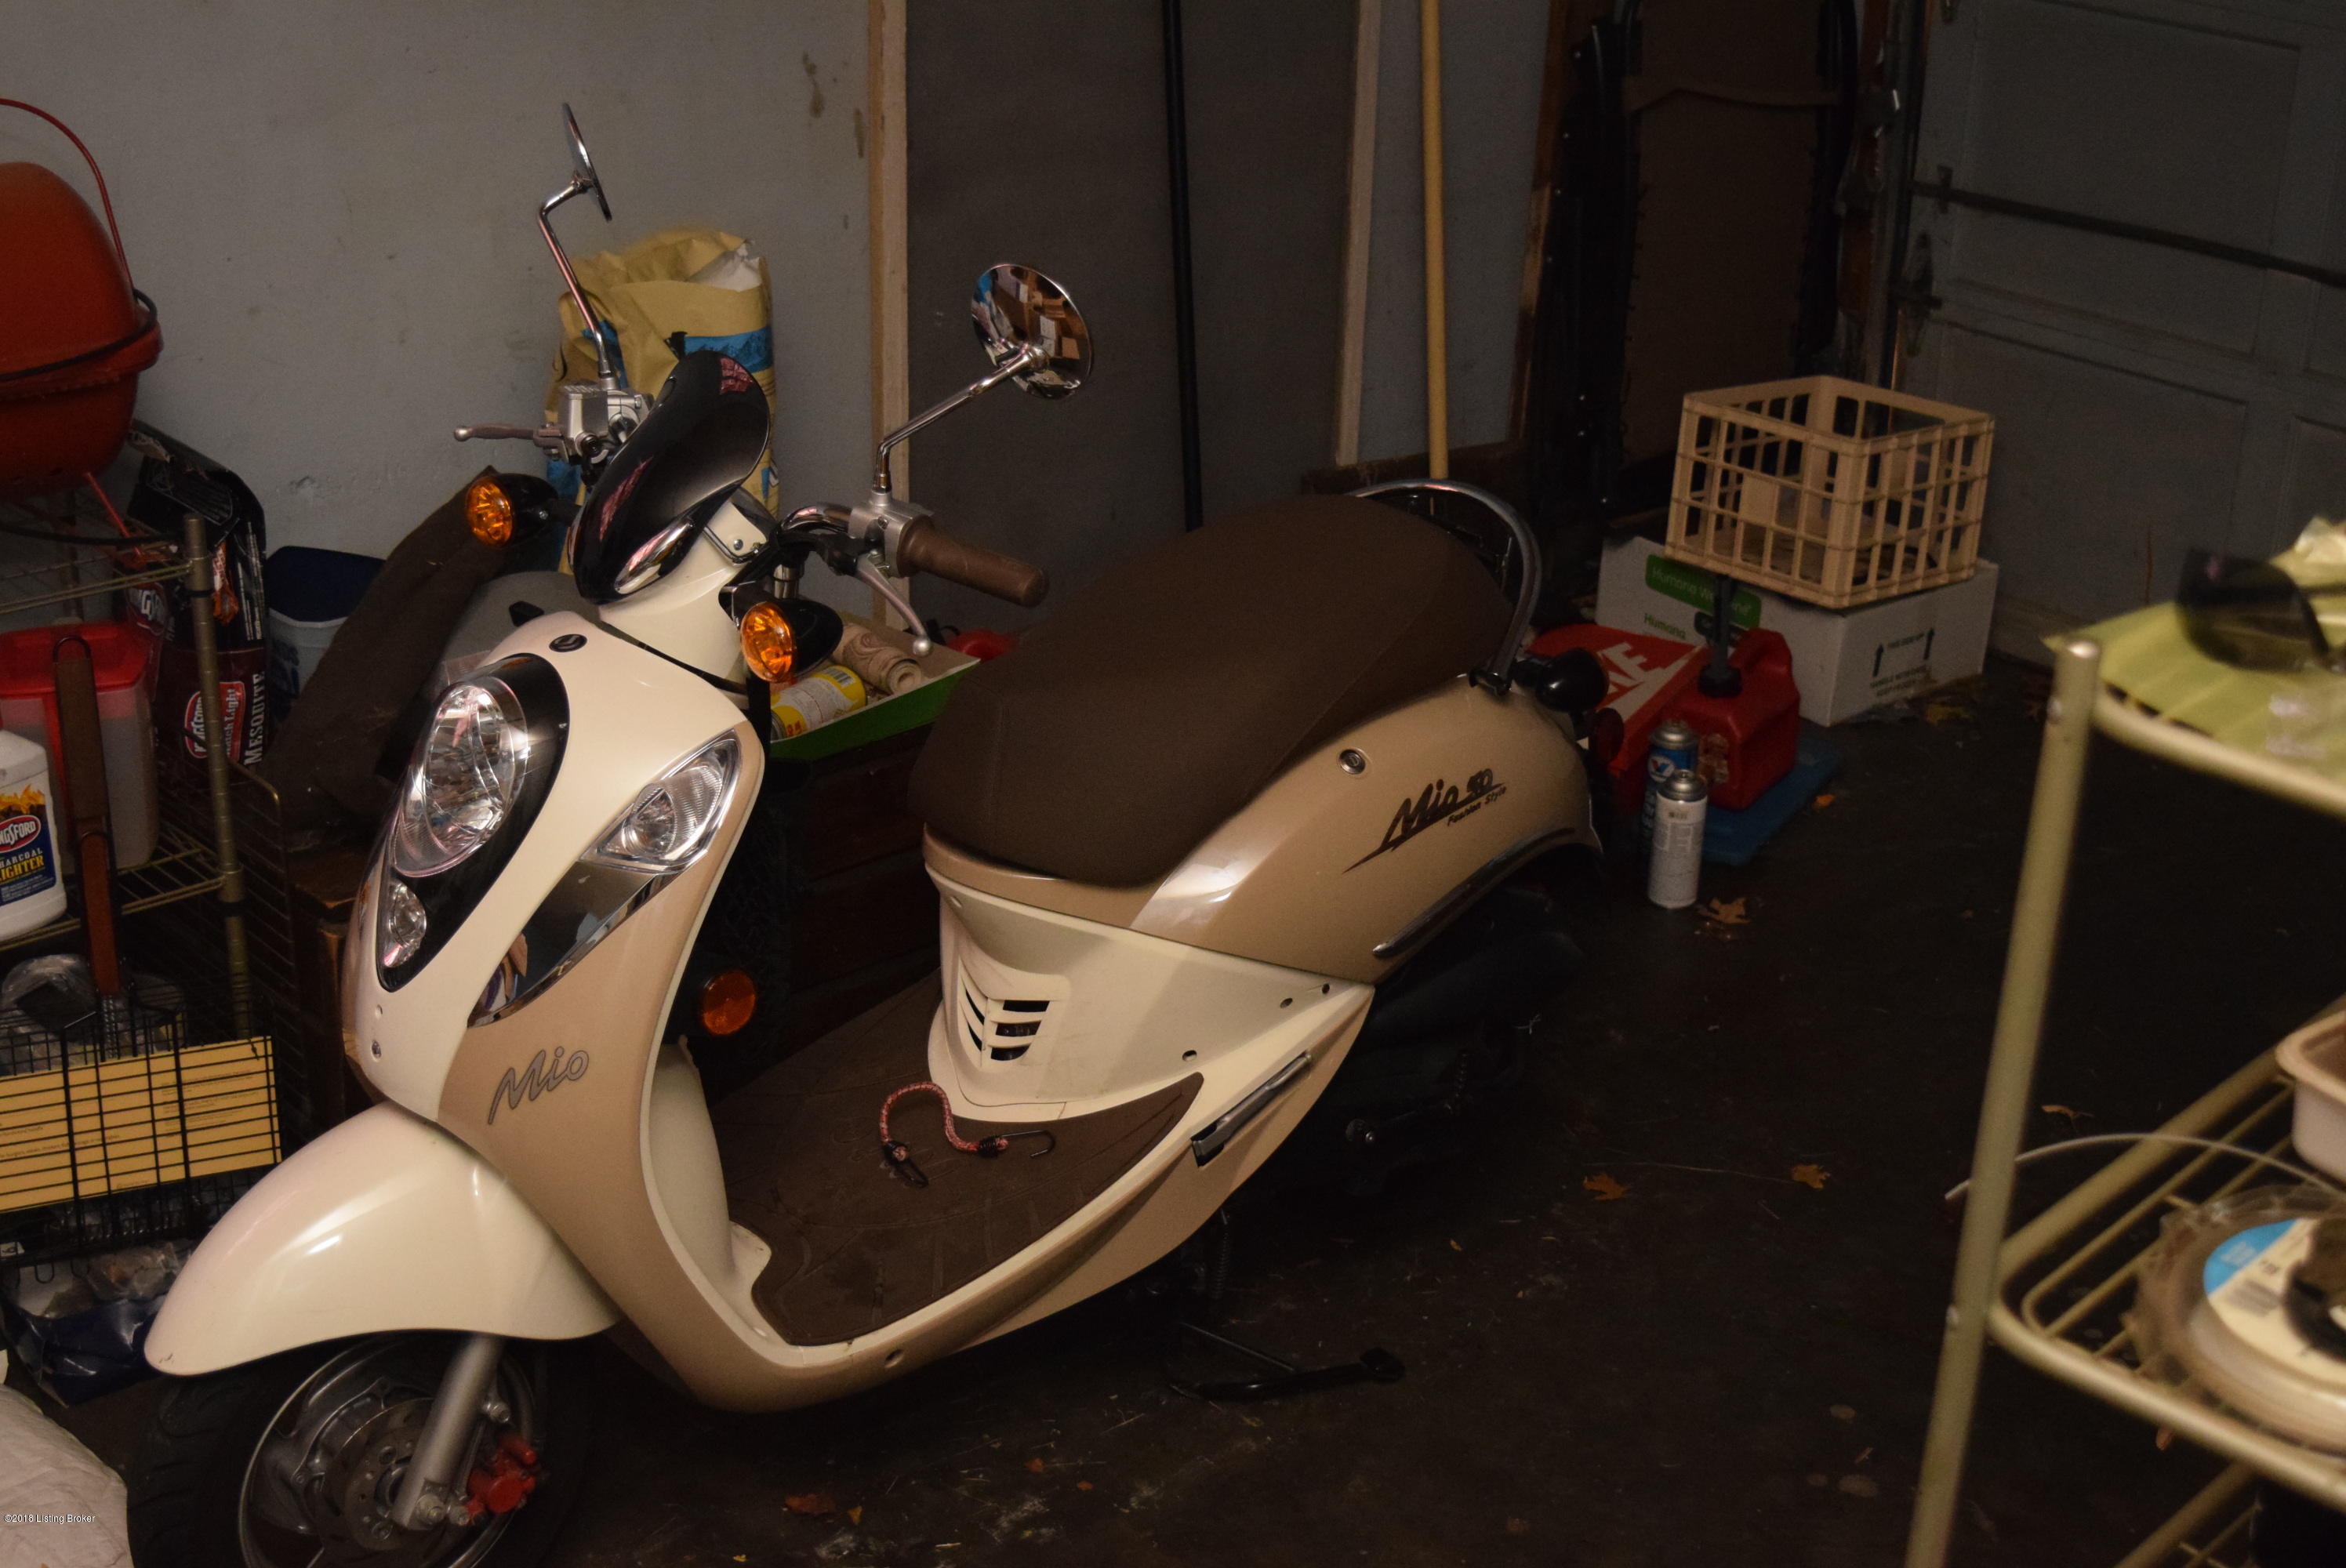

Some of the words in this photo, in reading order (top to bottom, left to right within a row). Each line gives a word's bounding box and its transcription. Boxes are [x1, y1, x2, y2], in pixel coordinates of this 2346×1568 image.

[244, 671, 265, 766] MESQUITE
[0, 820, 37, 846] NGSFORD
[1379, 778, 1460, 848] Mio
[0, 847, 43, 868] HARCOAL
[0, 855, 45, 882] IGHTER
[488, 1046, 590, 1125] Mio
